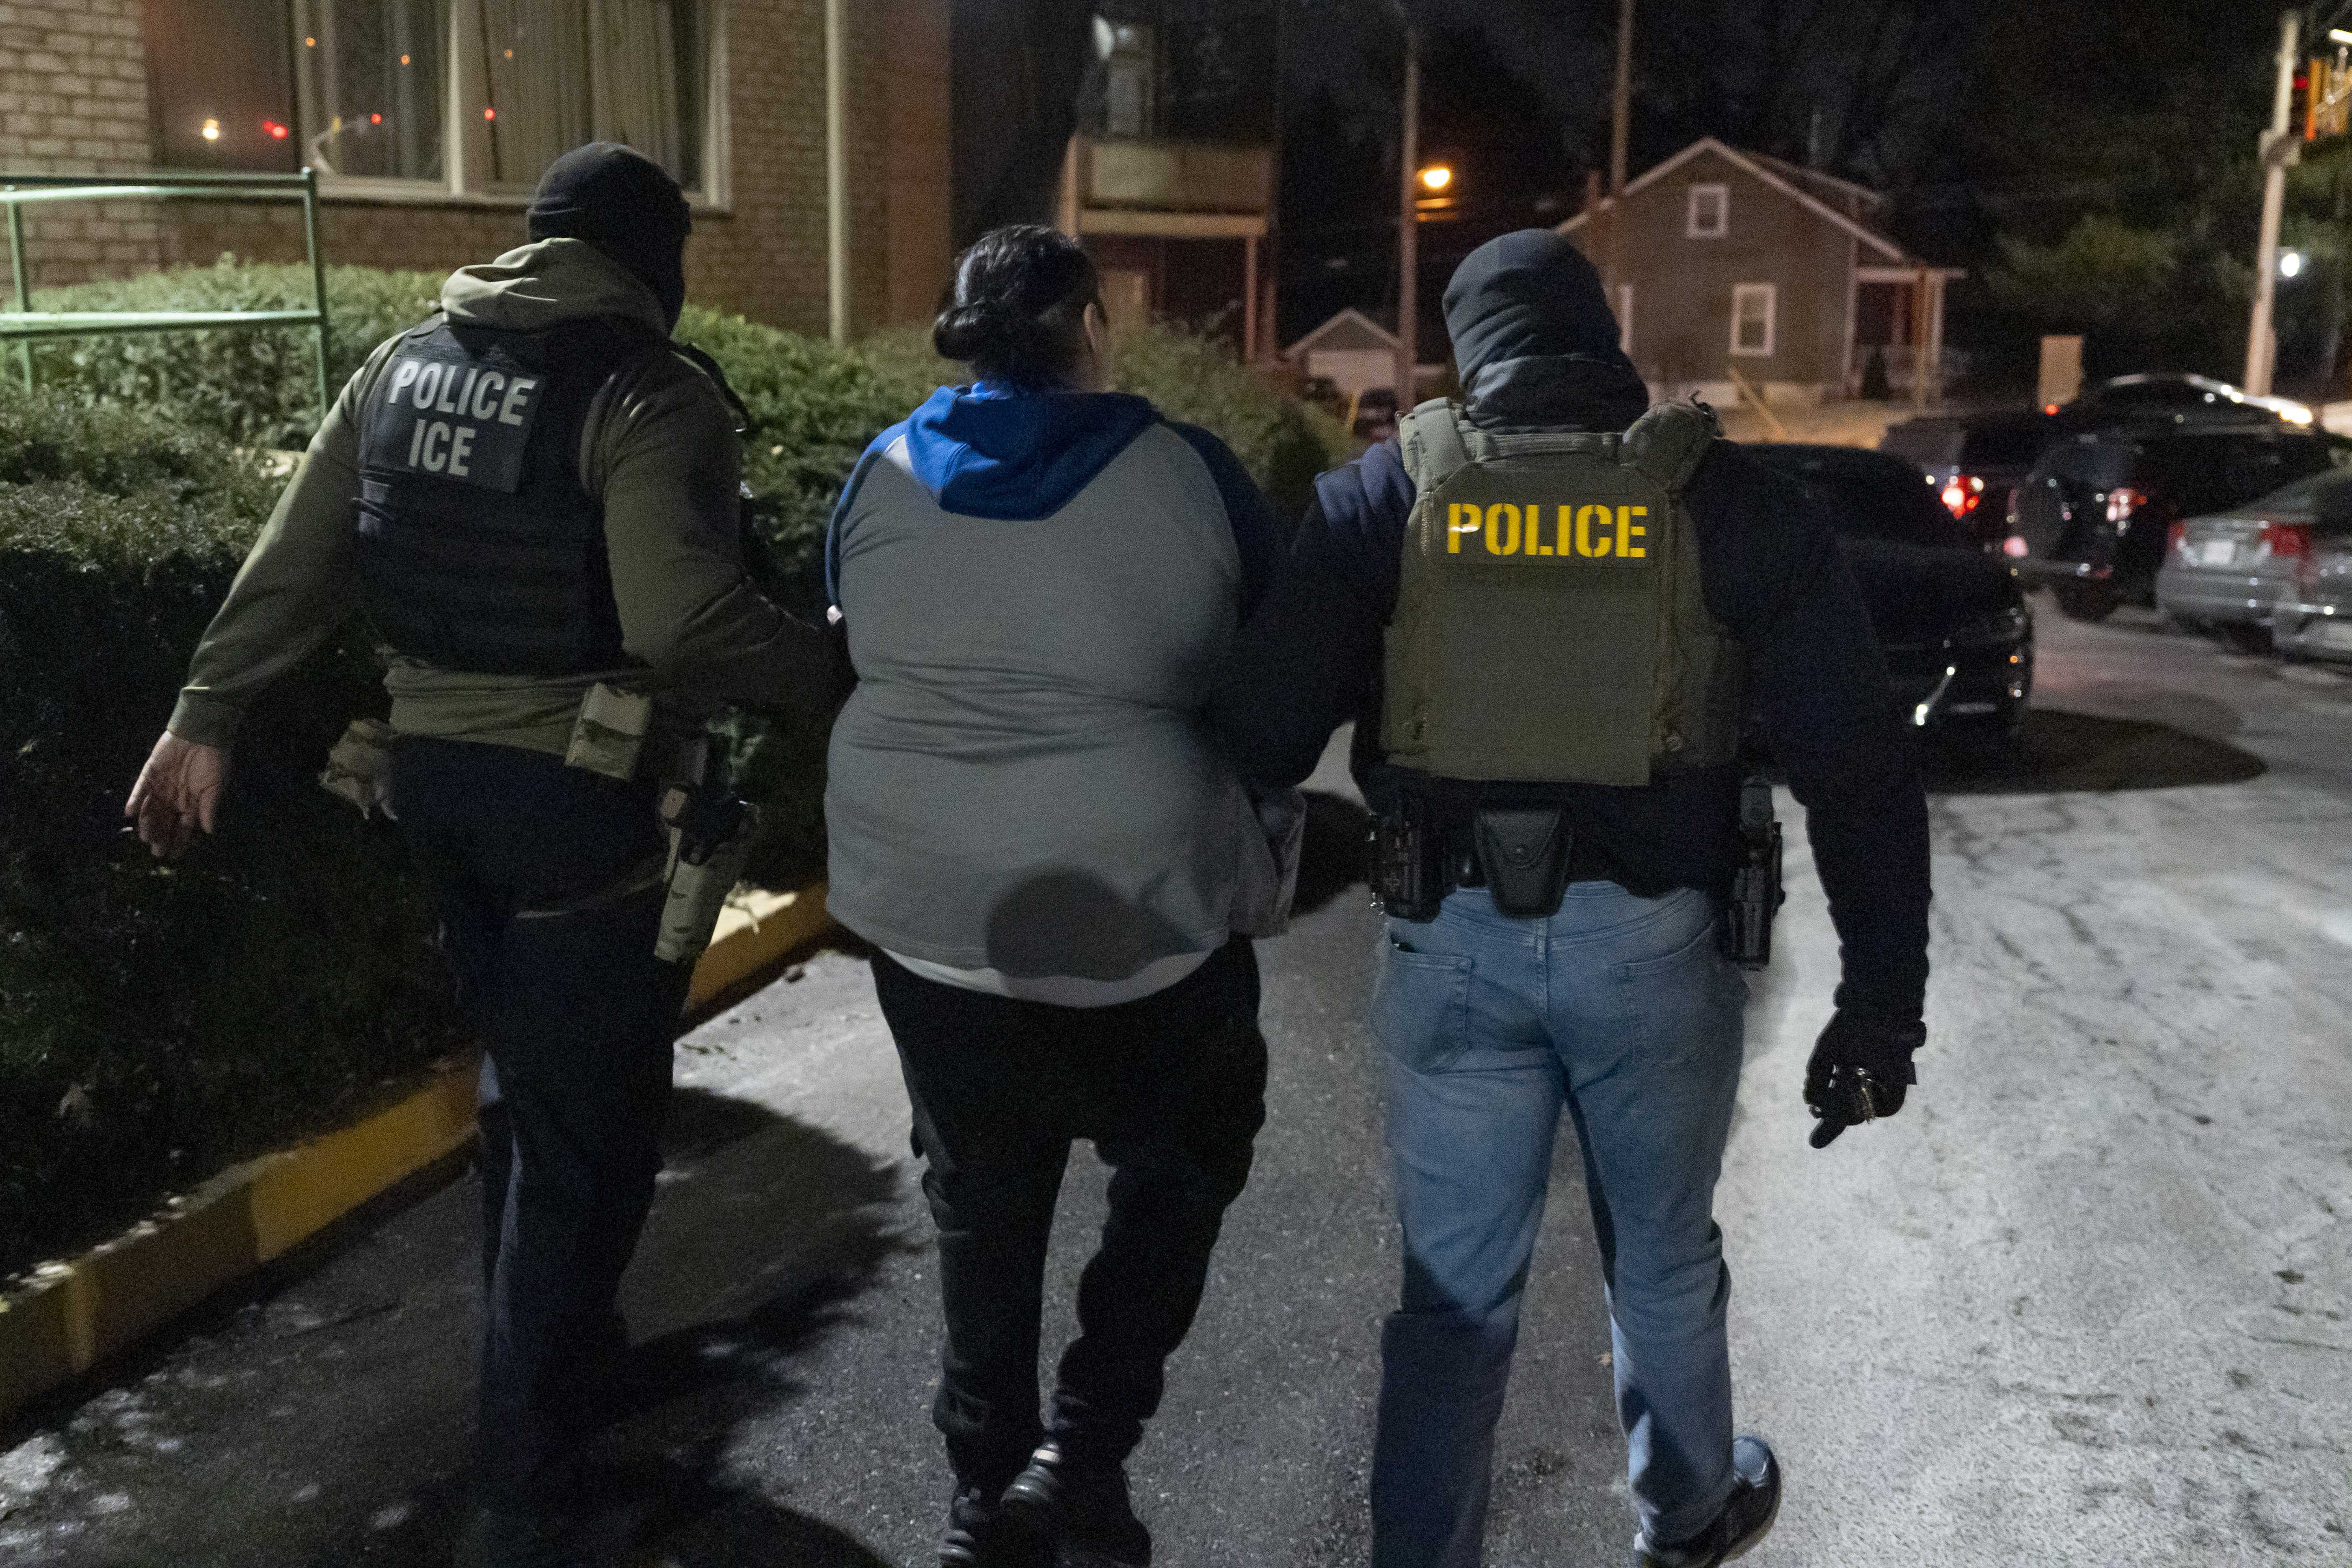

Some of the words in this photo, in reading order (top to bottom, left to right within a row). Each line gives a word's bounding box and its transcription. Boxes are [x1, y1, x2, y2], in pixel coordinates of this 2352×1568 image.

[389, 361, 536, 426] POLICE
[409, 419, 476, 477] ICE
[1447, 503, 1647, 558] POLICE
